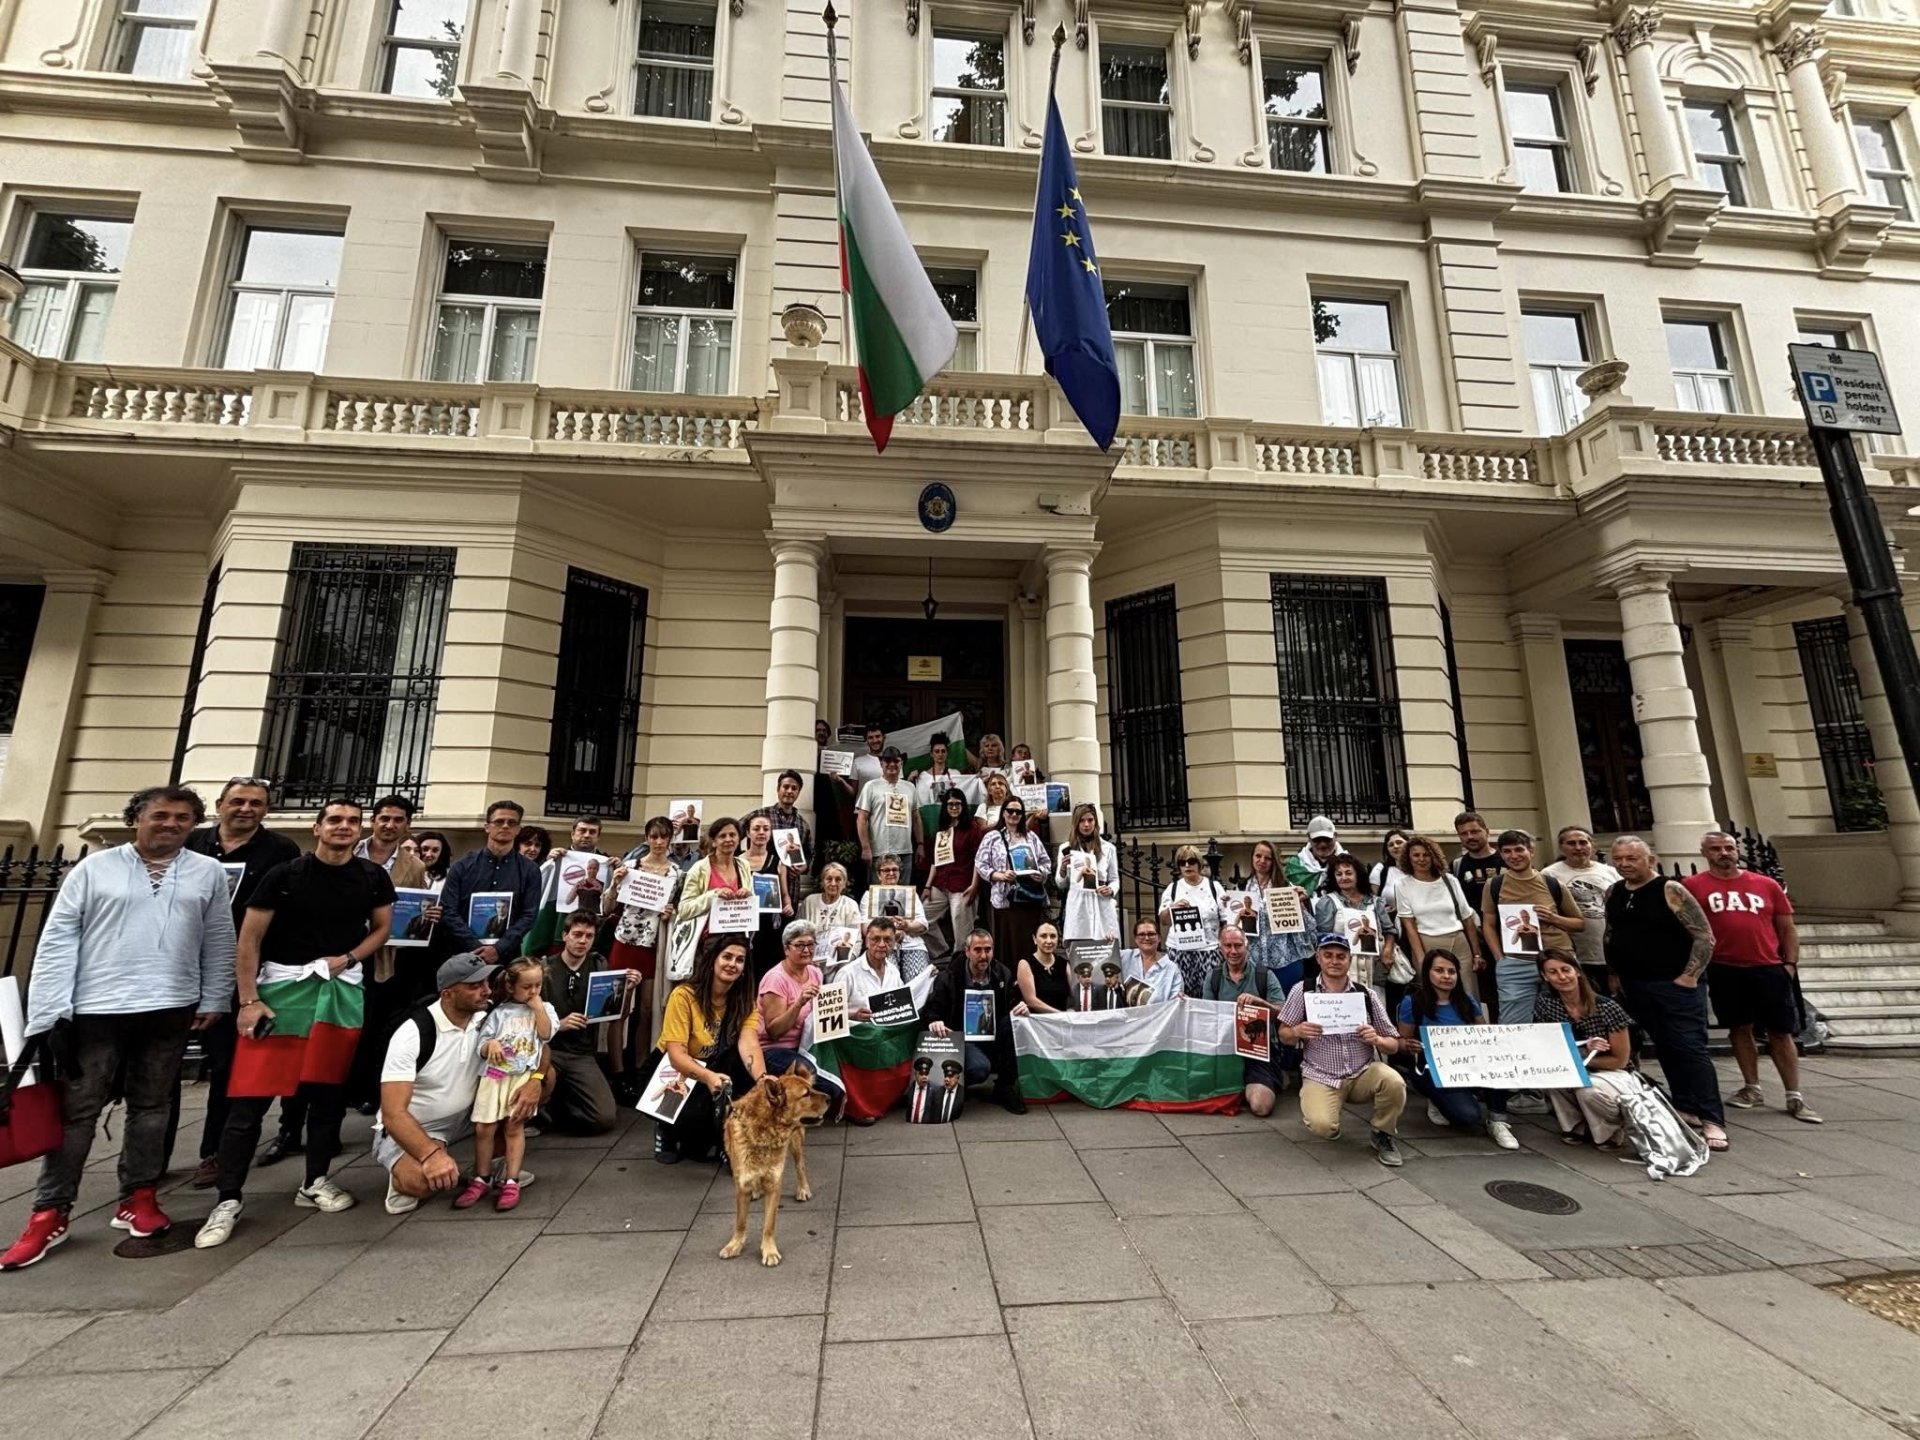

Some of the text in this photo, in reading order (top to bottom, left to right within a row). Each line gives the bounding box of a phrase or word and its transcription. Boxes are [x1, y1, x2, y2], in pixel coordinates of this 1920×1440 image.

[1809, 376, 1884, 399] P Resident
[1844, 391, 1881, 402] permit
[1846, 402, 1887, 413] holders
[1824, 410, 1833, 420] A
[1858, 414, 1881, 425] only
[1708, 891, 1765, 915] GAP
[1275, 919, 1299, 928] YOU!
[817, 990, 837, 1001] ДНЕС
[818, 996, 843, 1008] БЛАГО
[818, 1007, 833, 1016] УТРЕ
[818, 1013, 844, 1034] ТИ
[1433, 1041, 1445, 1049] НЕ
[1450, 1055, 1476, 1066] WANT
[1449, 1073, 1470, 1082] NOT
